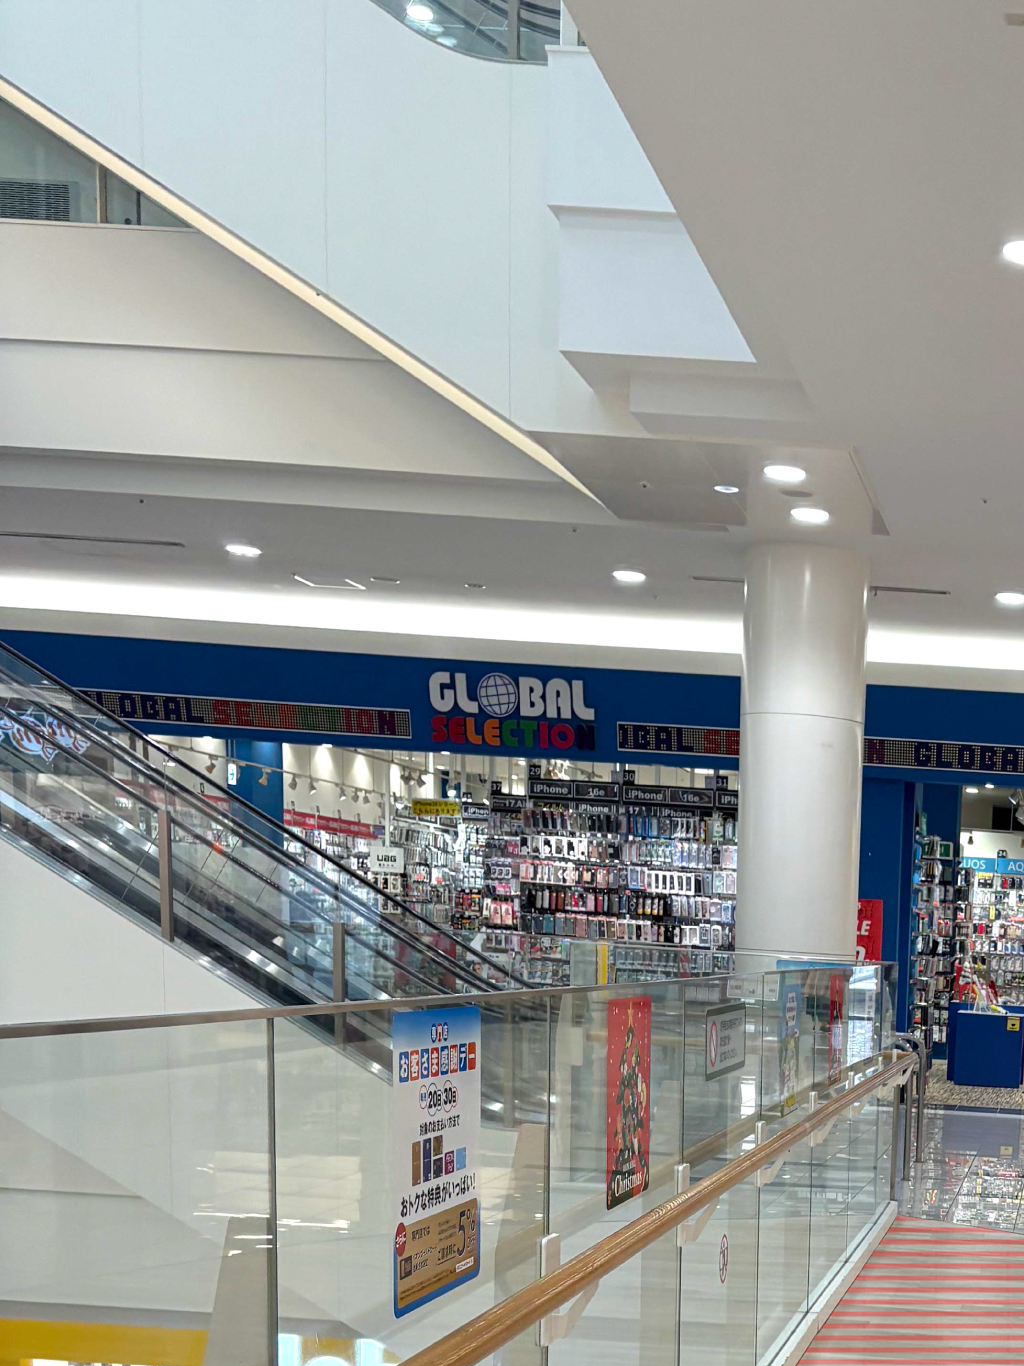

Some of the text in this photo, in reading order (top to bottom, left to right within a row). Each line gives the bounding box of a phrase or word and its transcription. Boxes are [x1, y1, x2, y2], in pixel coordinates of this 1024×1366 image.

[428, 671, 595, 721] GLOBAL
[430, 715, 596, 751] SELECTION
[533, 783, 605, 798] iPhone 16e
[399, 1042, 476, 1083] お客さま感謝デー
